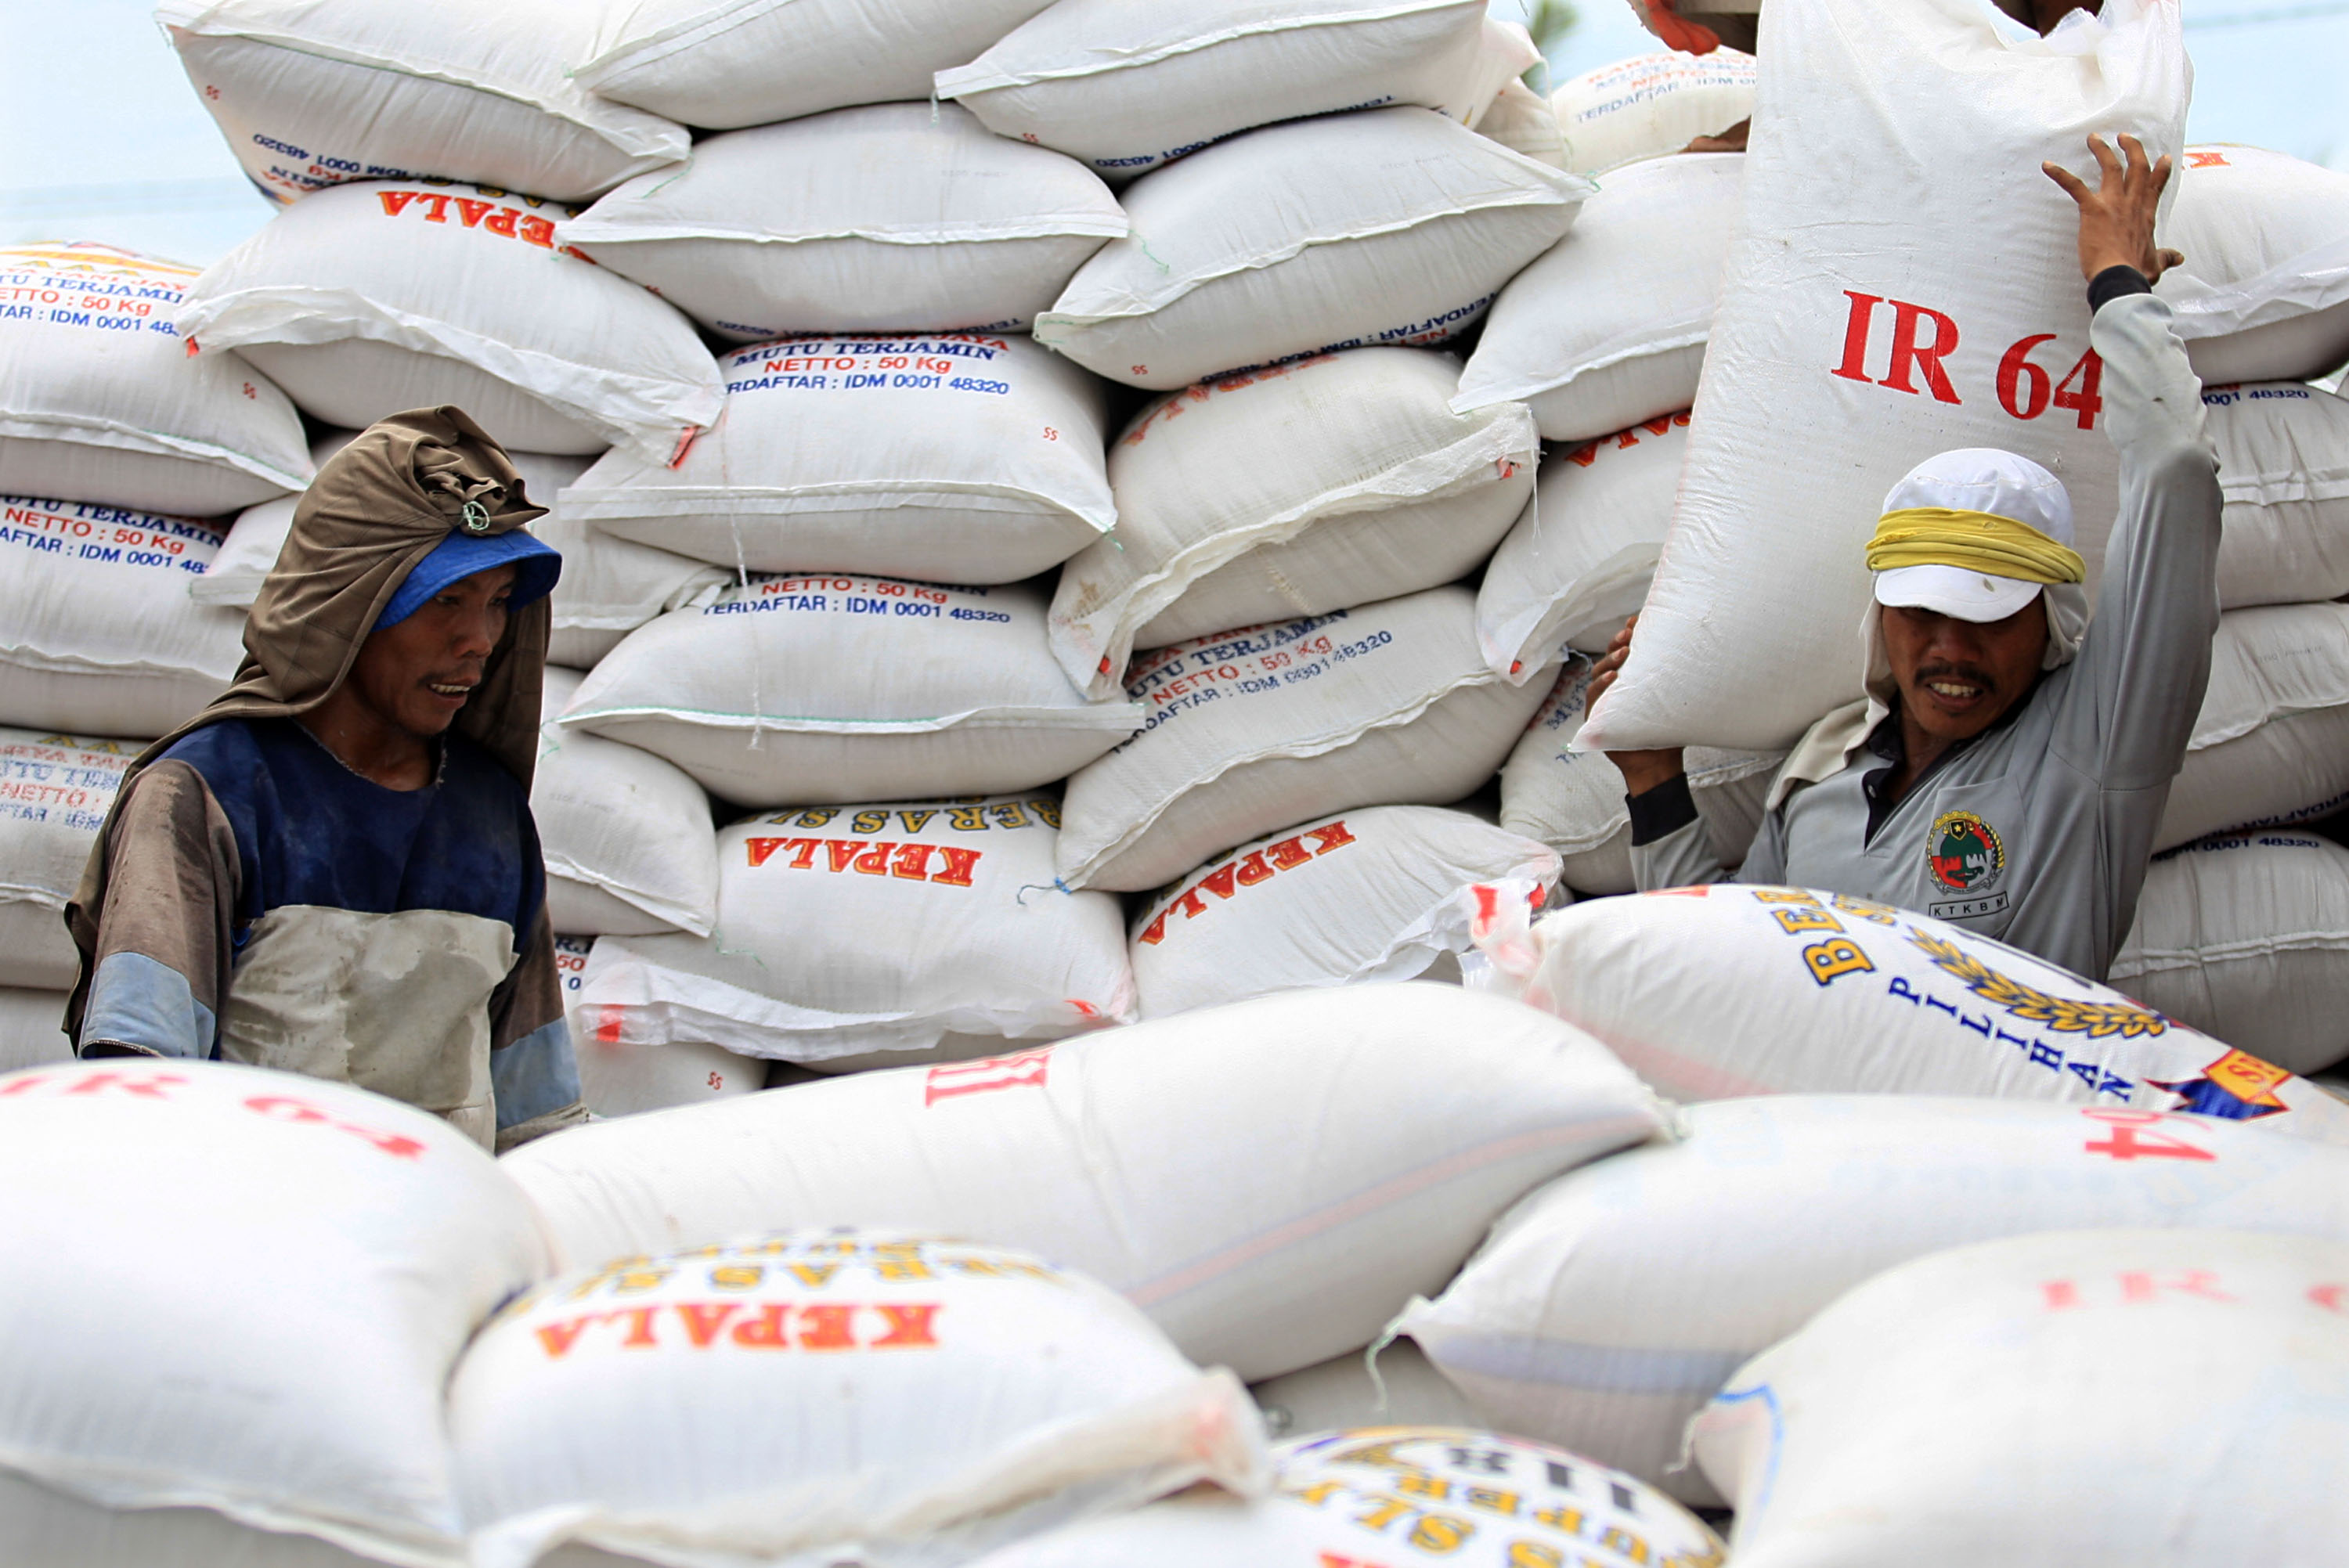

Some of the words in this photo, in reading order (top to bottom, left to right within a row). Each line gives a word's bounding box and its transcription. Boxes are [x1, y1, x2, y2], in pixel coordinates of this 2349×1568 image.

[1577, 81, 1680, 122] TERDAFTAR
[253, 133, 309, 159] 48320
[316, 155, 360, 174] 0001
[1095, 154, 1154, 168] 48320
[377, 190, 597, 265] EPALA
[50, 308, 91, 327] IDM
[96, 315, 142, 331] 0001
[81, 295, 110, 311] 50
[117, 299, 151, 316] Kg
[733, 342, 823, 367] MUTU
[834, 341, 998, 361] TERJAMIN
[763, 357, 855, 373] NETTO
[877, 357, 909, 370] 50
[915, 357, 953, 374] Kg
[1830, 289, 1963, 407] IR
[1995, 333, 2105, 431] 64
[845, 373, 886, 390] IDM
[893, 373, 940, 390] 0001
[949, 377, 1009, 395] 48320
[2250, 390, 2309, 399] 48320
[5, 508, 92, 537] NETTO
[113, 530, 144, 546] 50
[150, 535, 185, 555] Kg
[79, 543, 120, 564] IDM
[126, 553, 172, 568] 0001
[761, 578, 853, 596] NETTO
[876, 582, 906, 597] 50
[913, 586, 948, 604] Kg
[846, 597, 887, 615] IDM
[894, 601, 941, 618] 0001
[950, 607, 1011, 624] 48320
[1128, 661, 1185, 702] UTU
[1189, 610, 1349, 667] TERJAMIN
[1152, 665, 1240, 705] NETTO
[1260, 650, 1293, 672] 50
[1296, 636, 1333, 659] Kg
[1238, 675, 1281, 695] IDM
[1333, 629, 1394, 662] 48320
[0, 782, 88, 808] NETTO
[851, 798, 1063, 834] BERAS
[2203, 838, 2250, 852] 0001
[2258, 836, 2320, 849] 48320
[745, 837, 983, 888] KEPALA
[1138, 820, 1357, 946] KEPALA
[556, 953, 586, 972] 50
[1888, 976, 2135, 1102] PILIHAN
[535, 1303, 943, 1359] KEPALA
